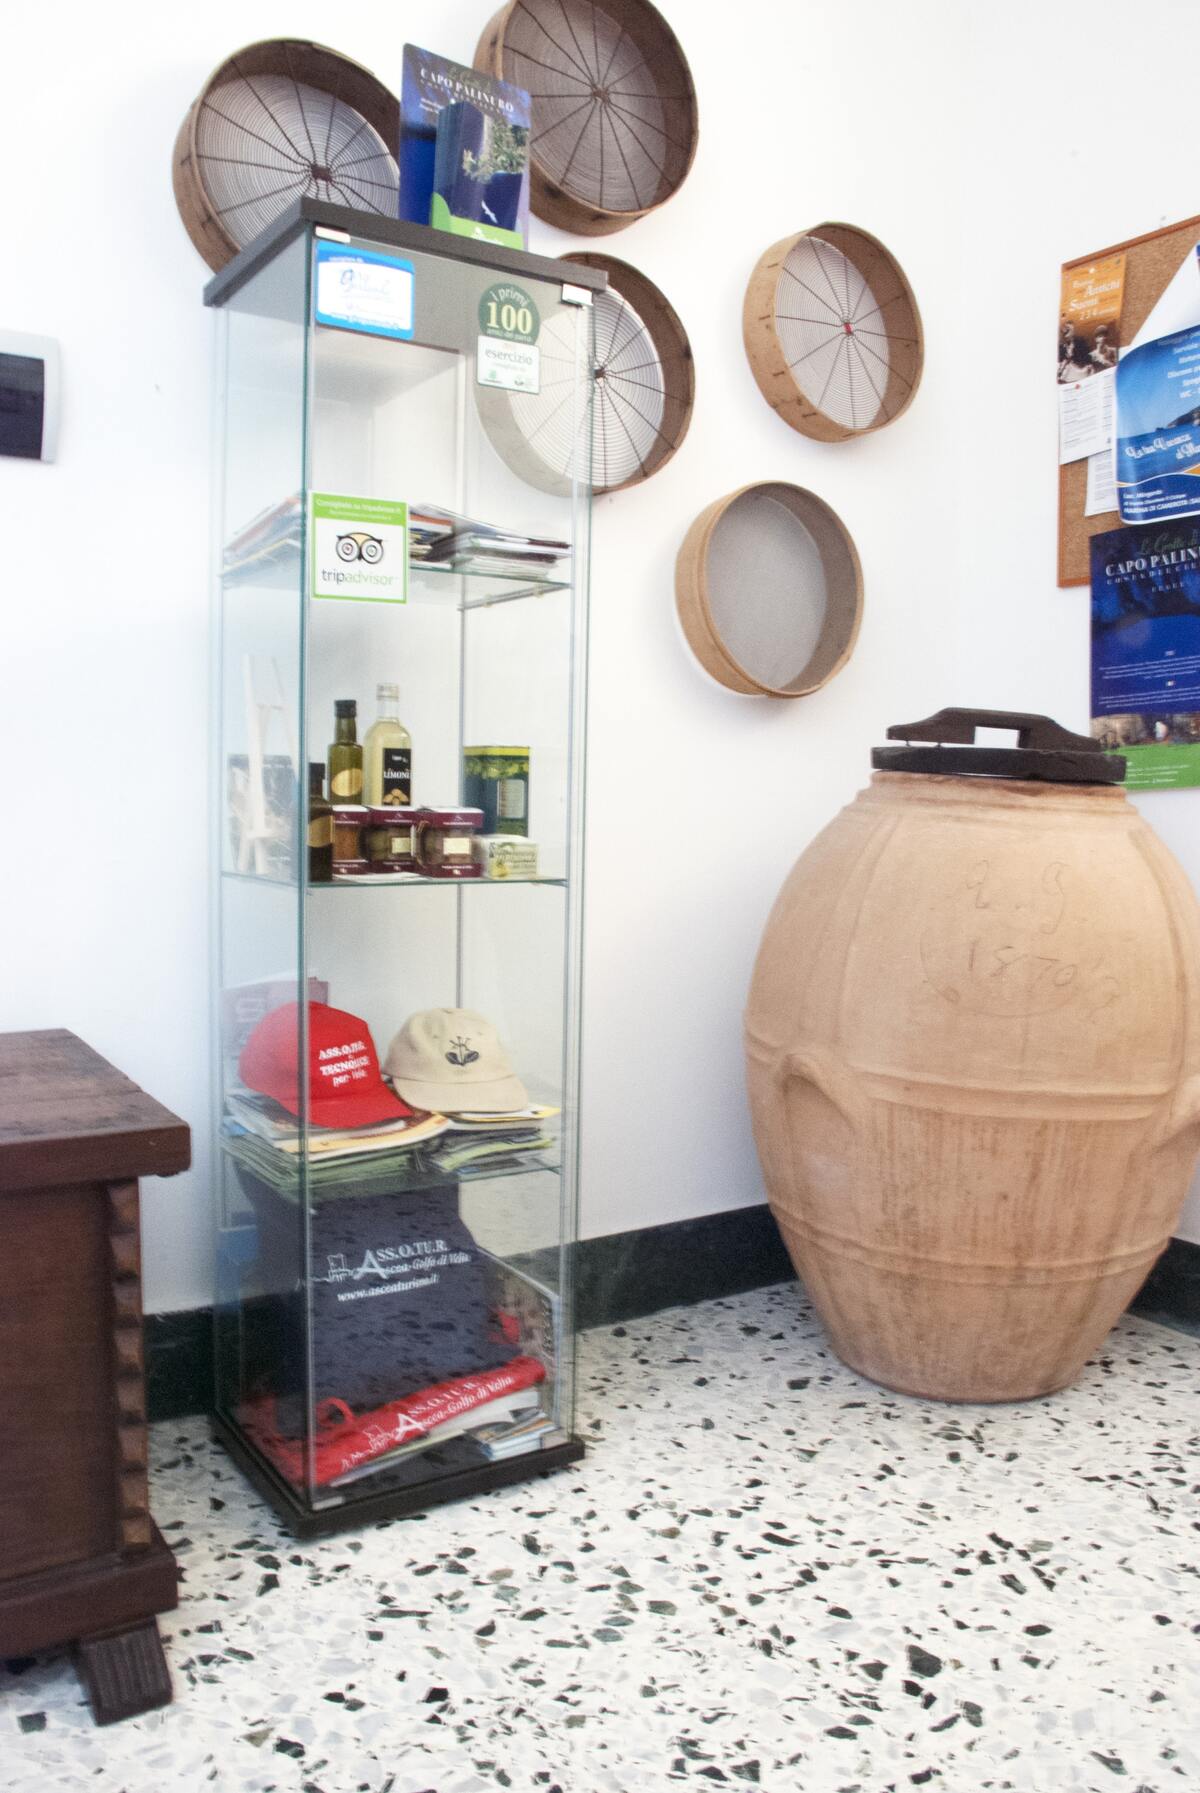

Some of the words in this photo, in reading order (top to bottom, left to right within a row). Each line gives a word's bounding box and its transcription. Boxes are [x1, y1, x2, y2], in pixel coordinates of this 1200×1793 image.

[486, 301, 533, 335] 100
[485, 348, 533, 365] esercizio
[1105, 558, 1147, 577] CAPO
[1150, 546, 1200, 568] PALIN
[321, 568, 392, 585] tripadvisor
